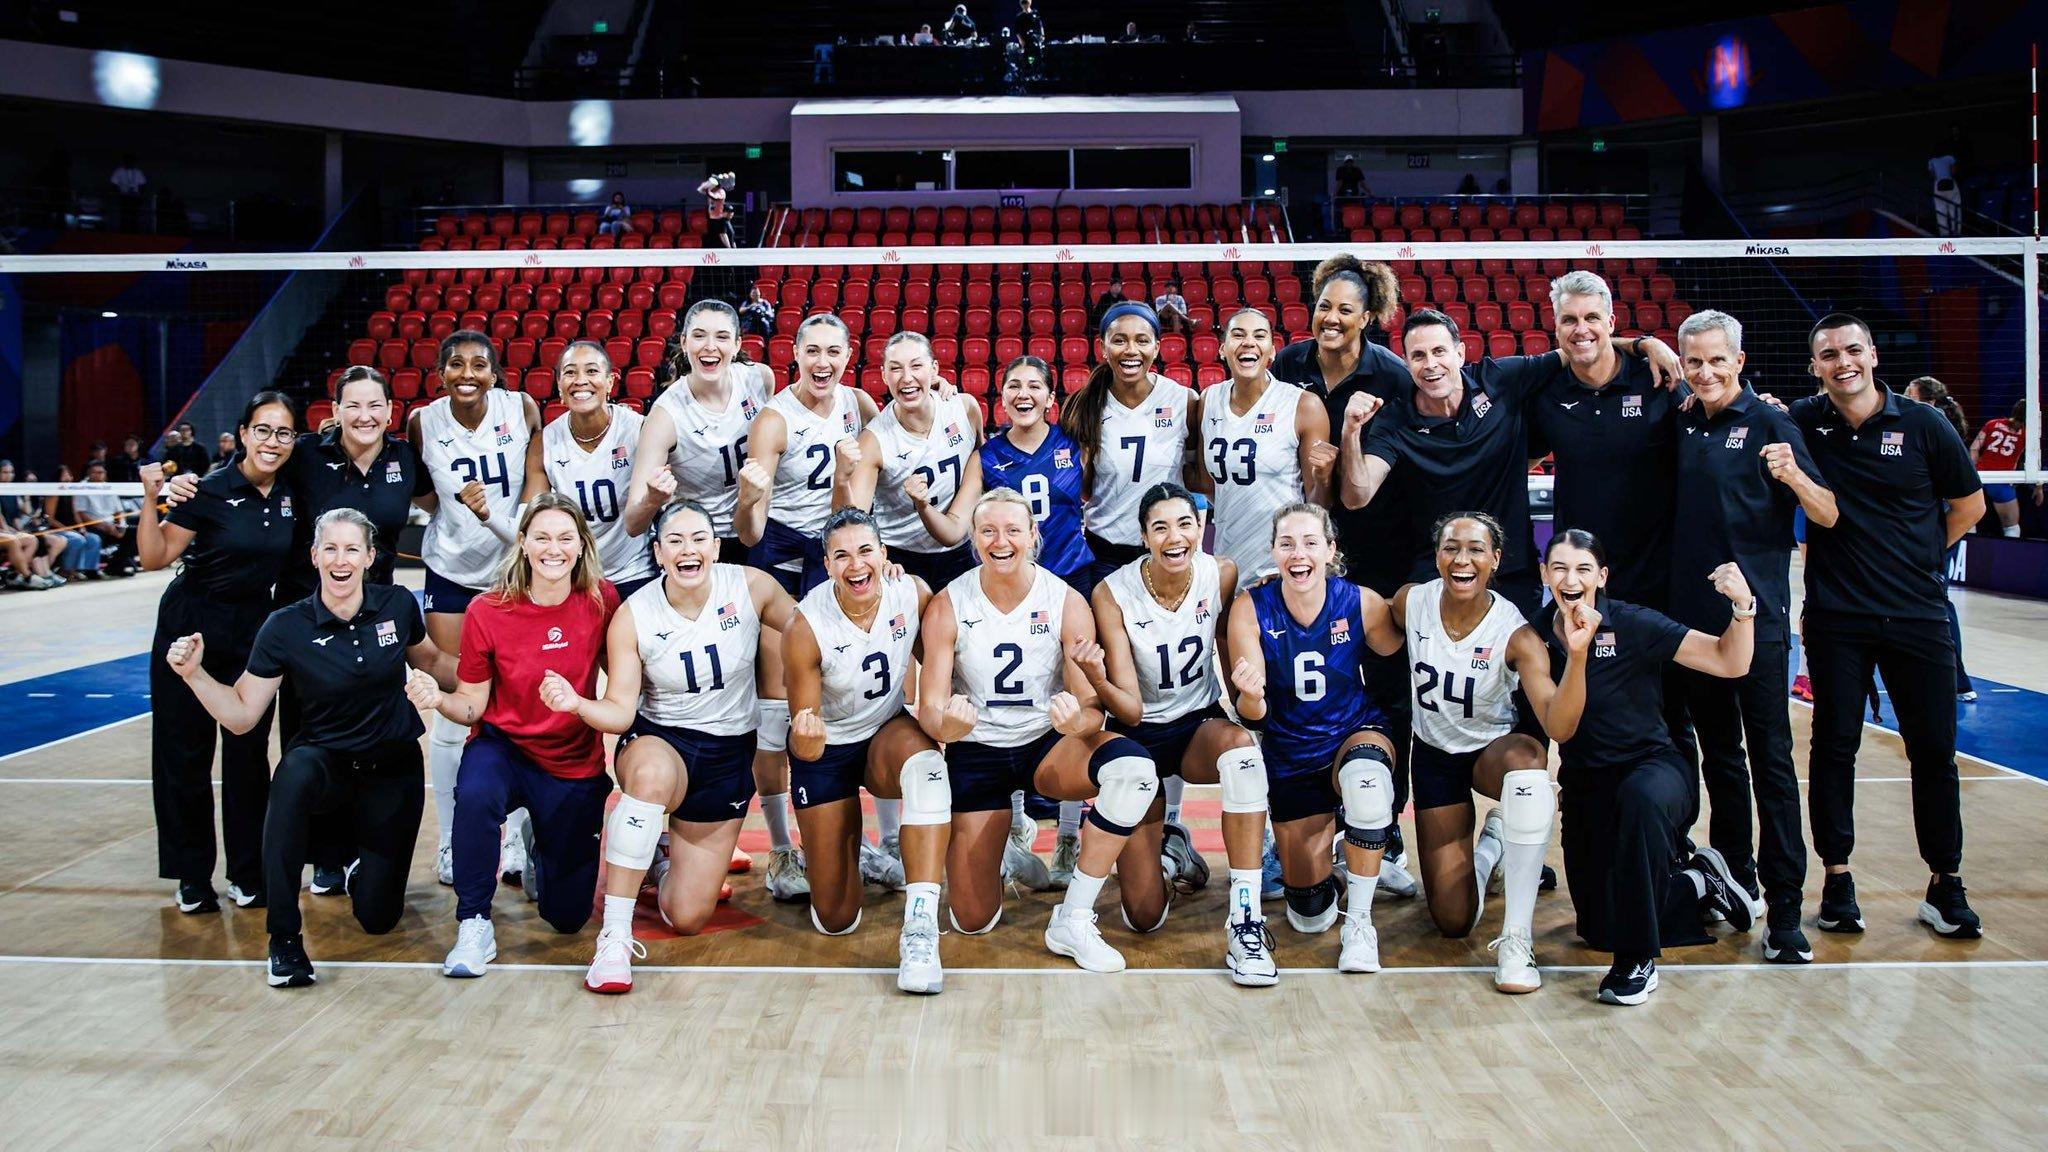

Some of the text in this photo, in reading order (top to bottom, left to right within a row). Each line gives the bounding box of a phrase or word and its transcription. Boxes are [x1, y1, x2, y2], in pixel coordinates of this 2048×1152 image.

[1408, 155, 1428, 167] 207
[1222, 247, 1241, 259] VNL
[1397, 246, 1416, 258] VNL
[1585, 244, 1604, 256] VNL
[1938, 241, 1956, 254] VNL
[524, 253, 542, 266] VNL
[702, 251, 720, 264] VNL
[882, 250, 901, 263] VNL
[1055, 248, 1074, 261] VNL
[349, 255, 367, 268] VNL
[1474, 400, 1492, 419] USA
[1622, 407, 1642, 418] USA
[1154, 419, 1172, 428] USA
[1254, 424, 1272, 434] USA
[496, 433, 513, 446] USA
[1725, 438, 1743, 449] USA
[1986, 430, 2018, 457] 25
[1880, 444, 1902, 456] USA
[611, 458, 629, 470] USA
[806, 441, 842, 490] 2
[1055, 459, 1074, 469] USA
[1119, 436, 1145, 482] 7
[1208, 437, 1257, 486] 33
[386, 472, 402, 484] USA
[451, 452, 510, 504] 34
[575, 479, 619, 522] 10
[1021, 472, 1050, 521] 8
[720, 616, 740, 631] USA
[1030, 624, 1049, 635] USA
[378, 633, 399, 647] USA
[1330, 631, 1350, 645] USA
[1594, 645, 1615, 658] USA
[679, 643, 724, 694] 11
[992, 643, 1022, 695] 2
[1156, 636, 1203, 690] 12
[1470, 659, 1489, 670] USA
[861, 651, 890, 700] 3
[1291, 650, 1325, 701] 6
[1413, 661, 1474, 718] 24
[798, 787, 808, 804] 3
